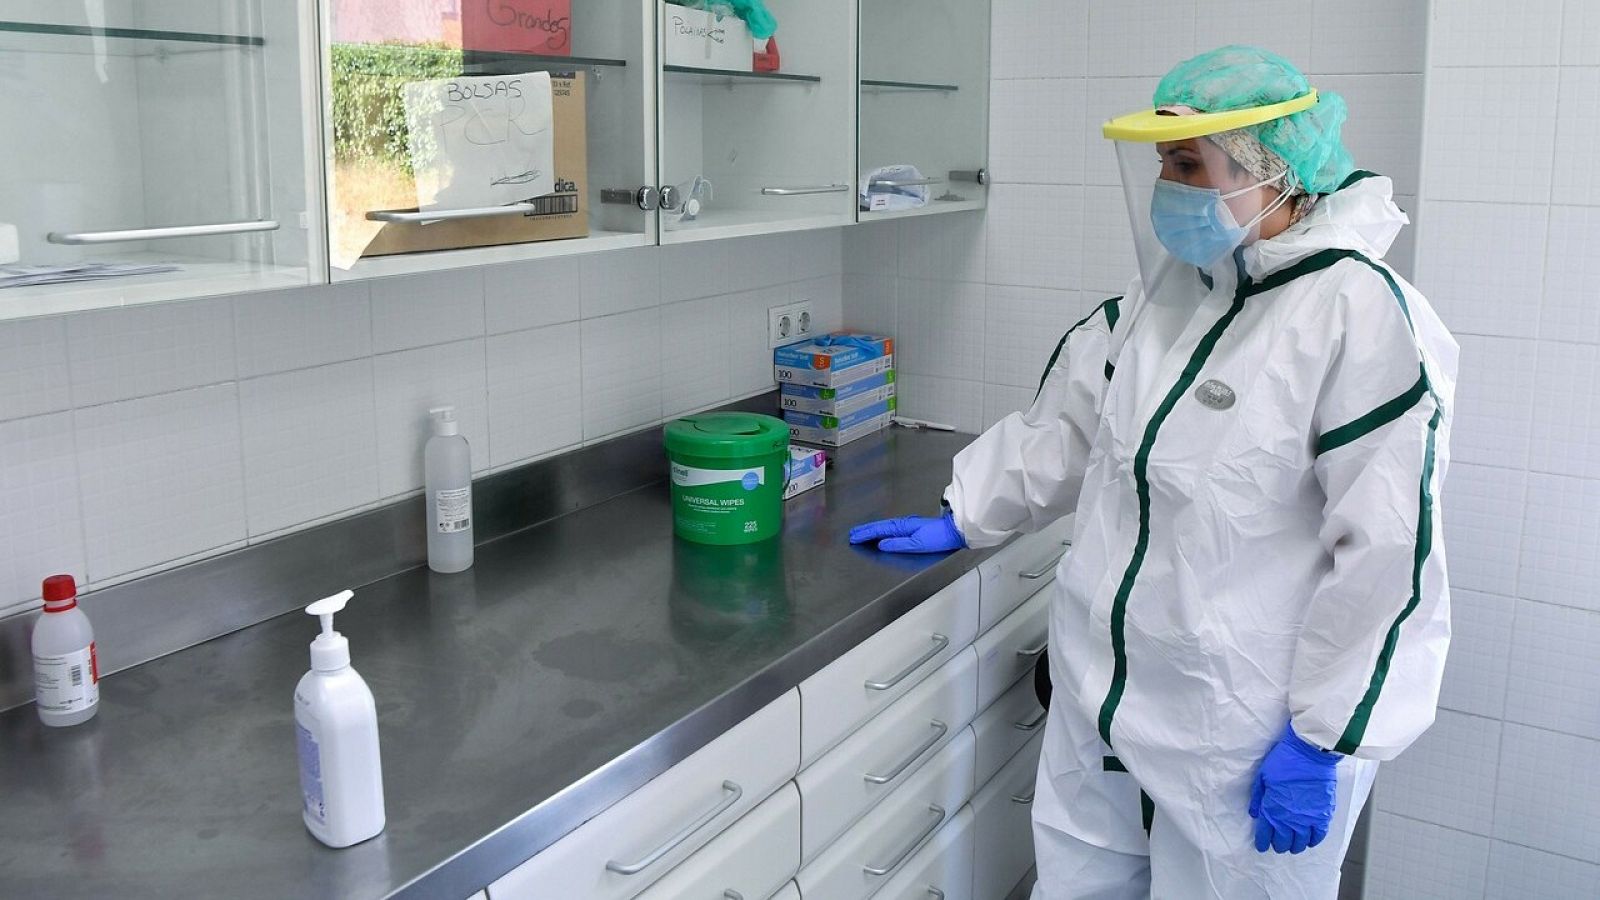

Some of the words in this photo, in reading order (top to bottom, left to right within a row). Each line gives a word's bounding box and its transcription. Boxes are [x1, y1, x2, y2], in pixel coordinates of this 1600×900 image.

[447, 79, 523, 101] BOLSAS
[554, 177, 578, 193] dica.
[777, 369, 792, 380] 100
[784, 398, 797, 407] 100
[789, 428, 800, 437] 00
[682, 495, 719, 506] UNIVERSAL
[720, 498, 745, 506] WIPES
